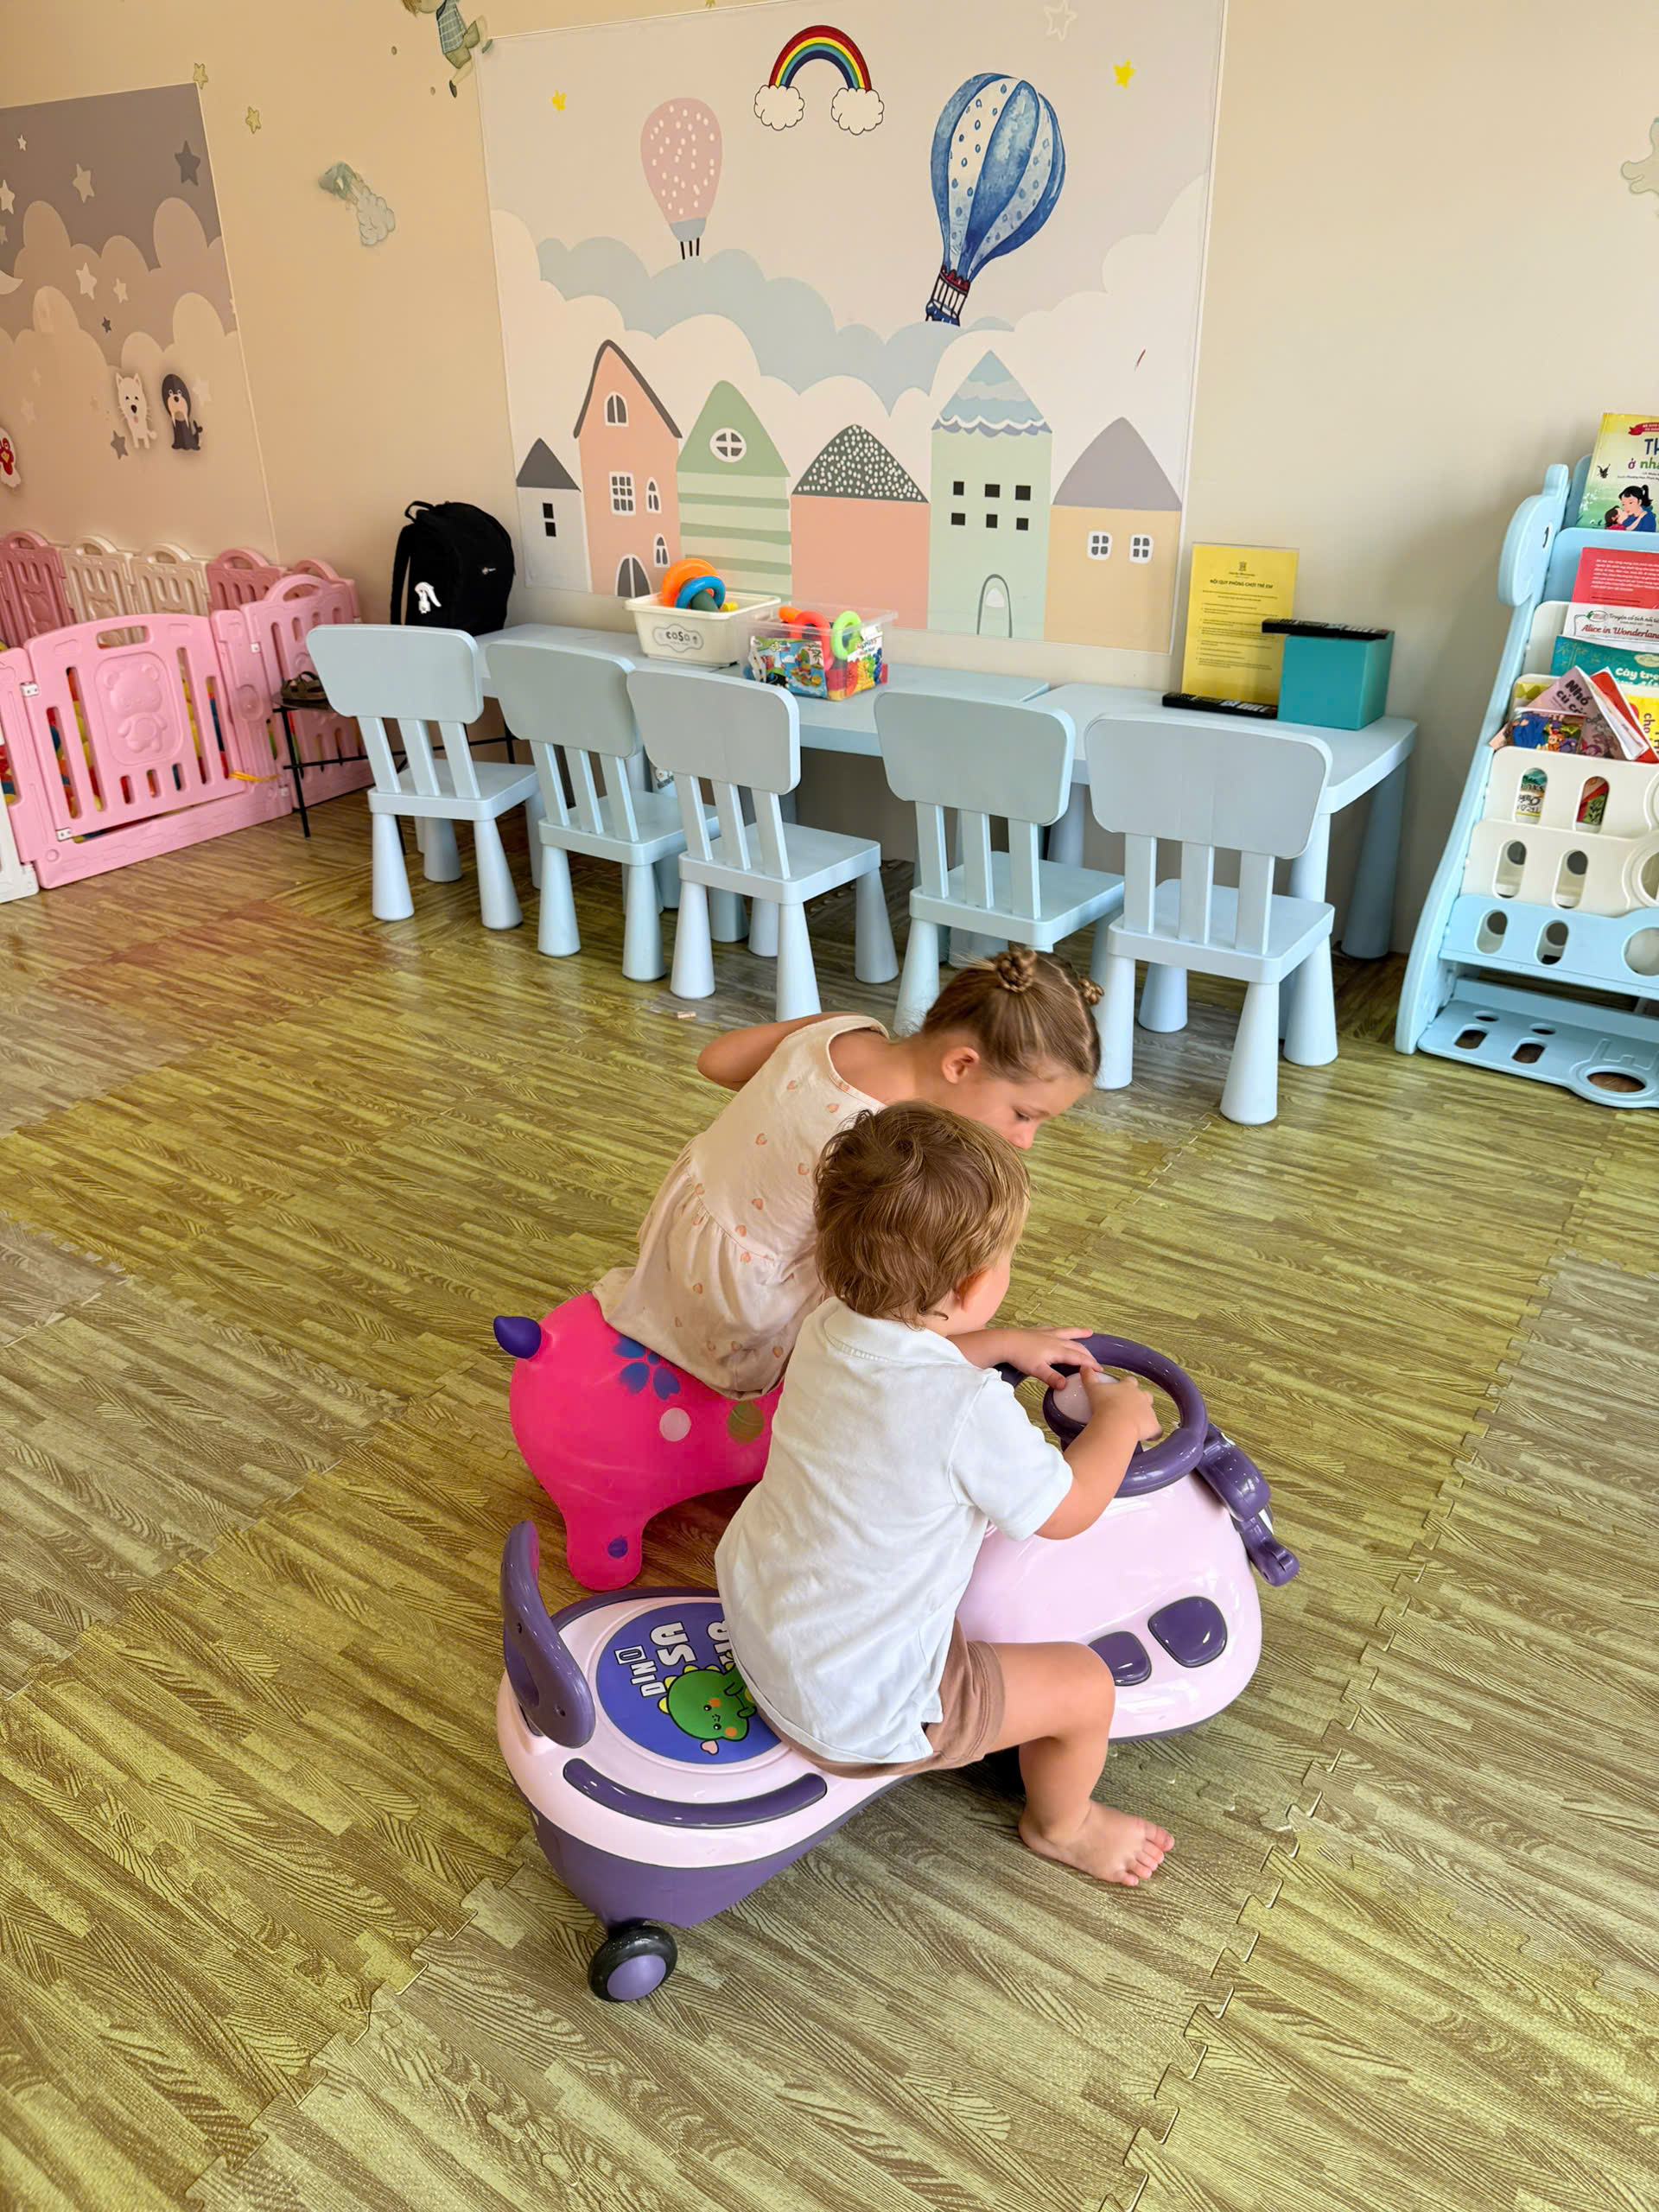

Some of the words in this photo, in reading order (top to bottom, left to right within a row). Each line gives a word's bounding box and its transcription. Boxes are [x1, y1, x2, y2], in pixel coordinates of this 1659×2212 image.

[1581, 624, 1602, 632] Alice
[1603, 626, 1611, 634] in
[613, 1644, 667, 1698] DINO
